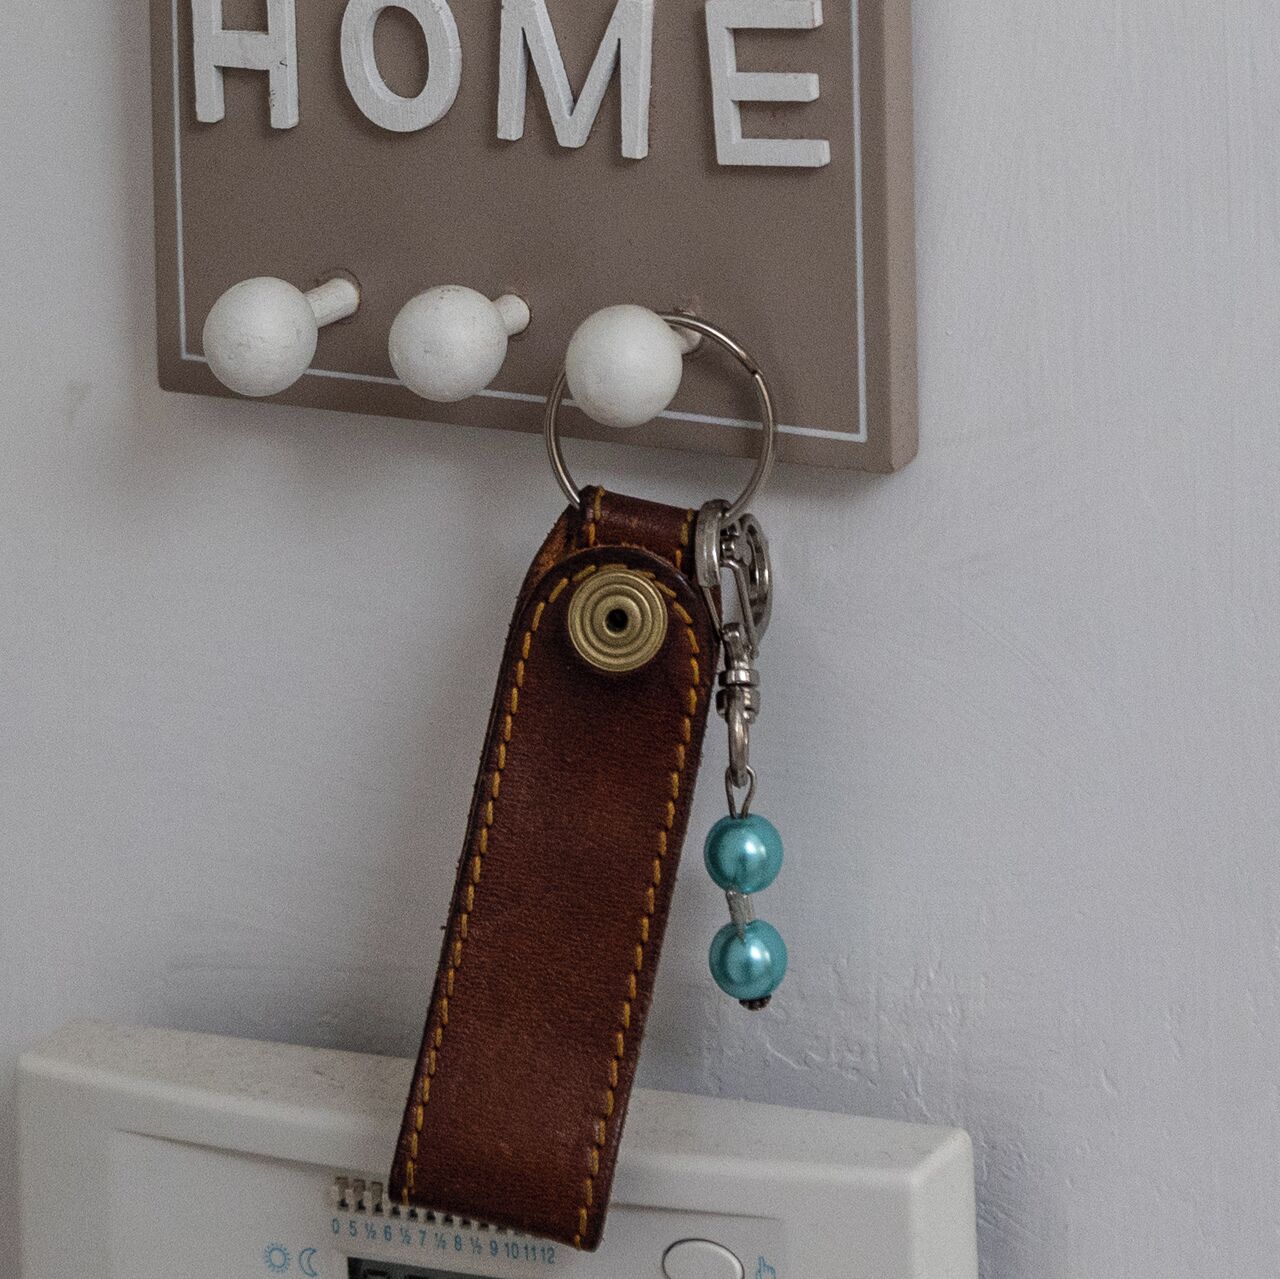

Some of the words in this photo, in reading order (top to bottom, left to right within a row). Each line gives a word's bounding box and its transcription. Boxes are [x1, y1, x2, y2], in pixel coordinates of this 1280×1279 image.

[332, 1218, 341, 1235] 0
[349, 1221, 358, 1238] 5
[383, 1225, 393, 1242] 6
[419, 1230, 428, 1247] 7
[454, 1234, 463, 1252] 8
[490, 1240, 500, 1258] 9
[505, 1242, 521, 1260] 10
[524, 1244, 539, 1262] 11
[541, 1246, 557, 1265] 12
